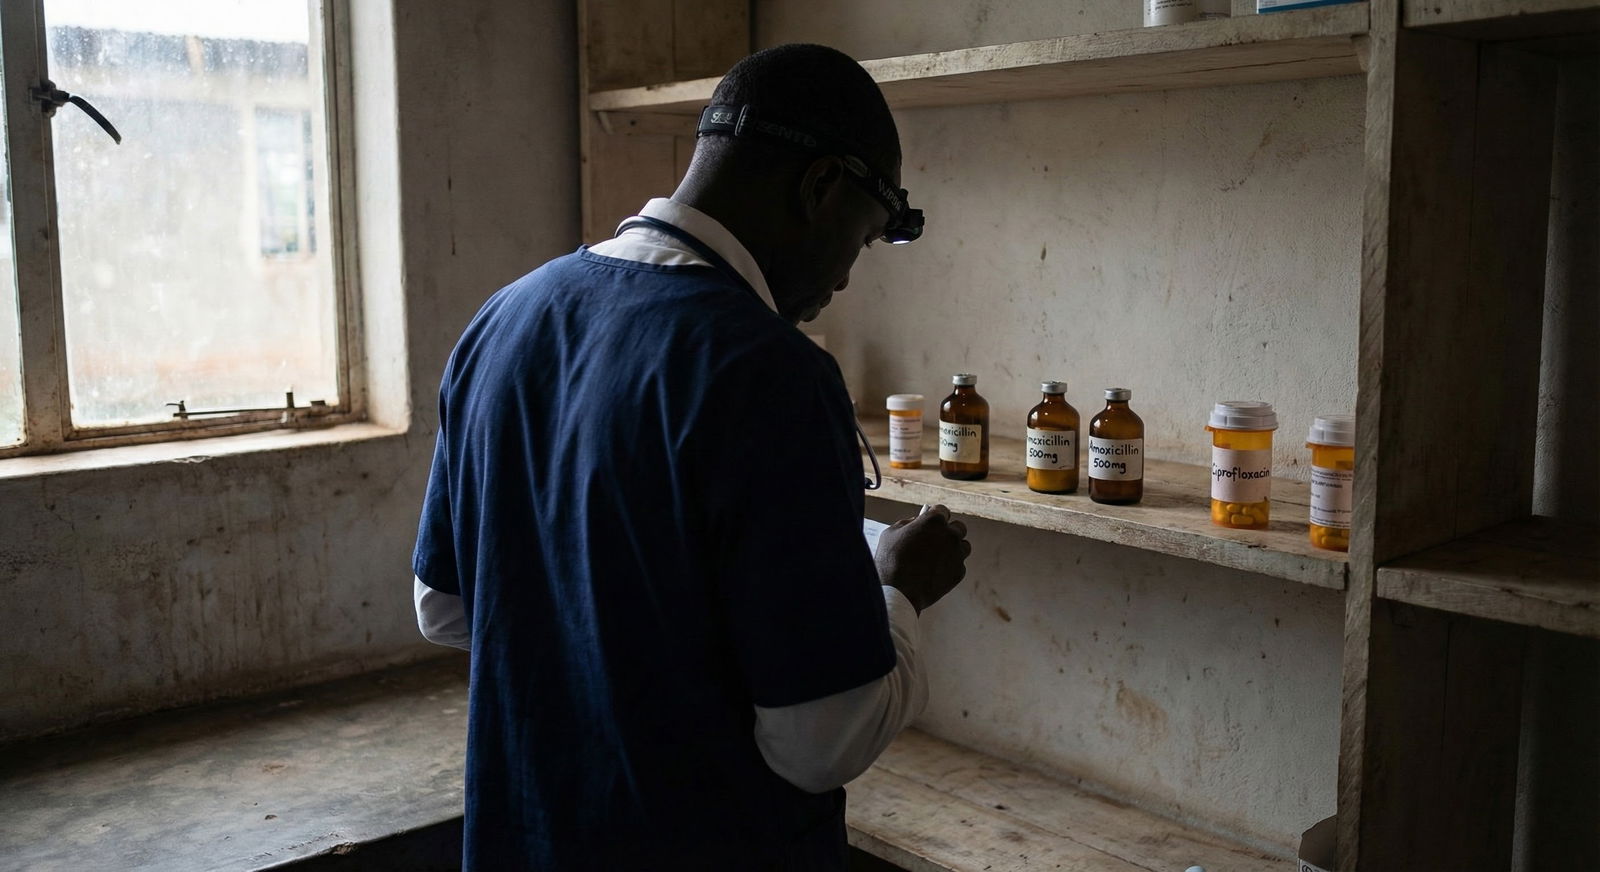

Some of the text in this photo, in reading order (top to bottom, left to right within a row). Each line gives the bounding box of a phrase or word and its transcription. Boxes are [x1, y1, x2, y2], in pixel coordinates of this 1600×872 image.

[1029, 447, 1058, 464] 500mg
[1089, 439, 1139, 456] Amoxicillin
[1093, 457, 1127, 475] 500mg
